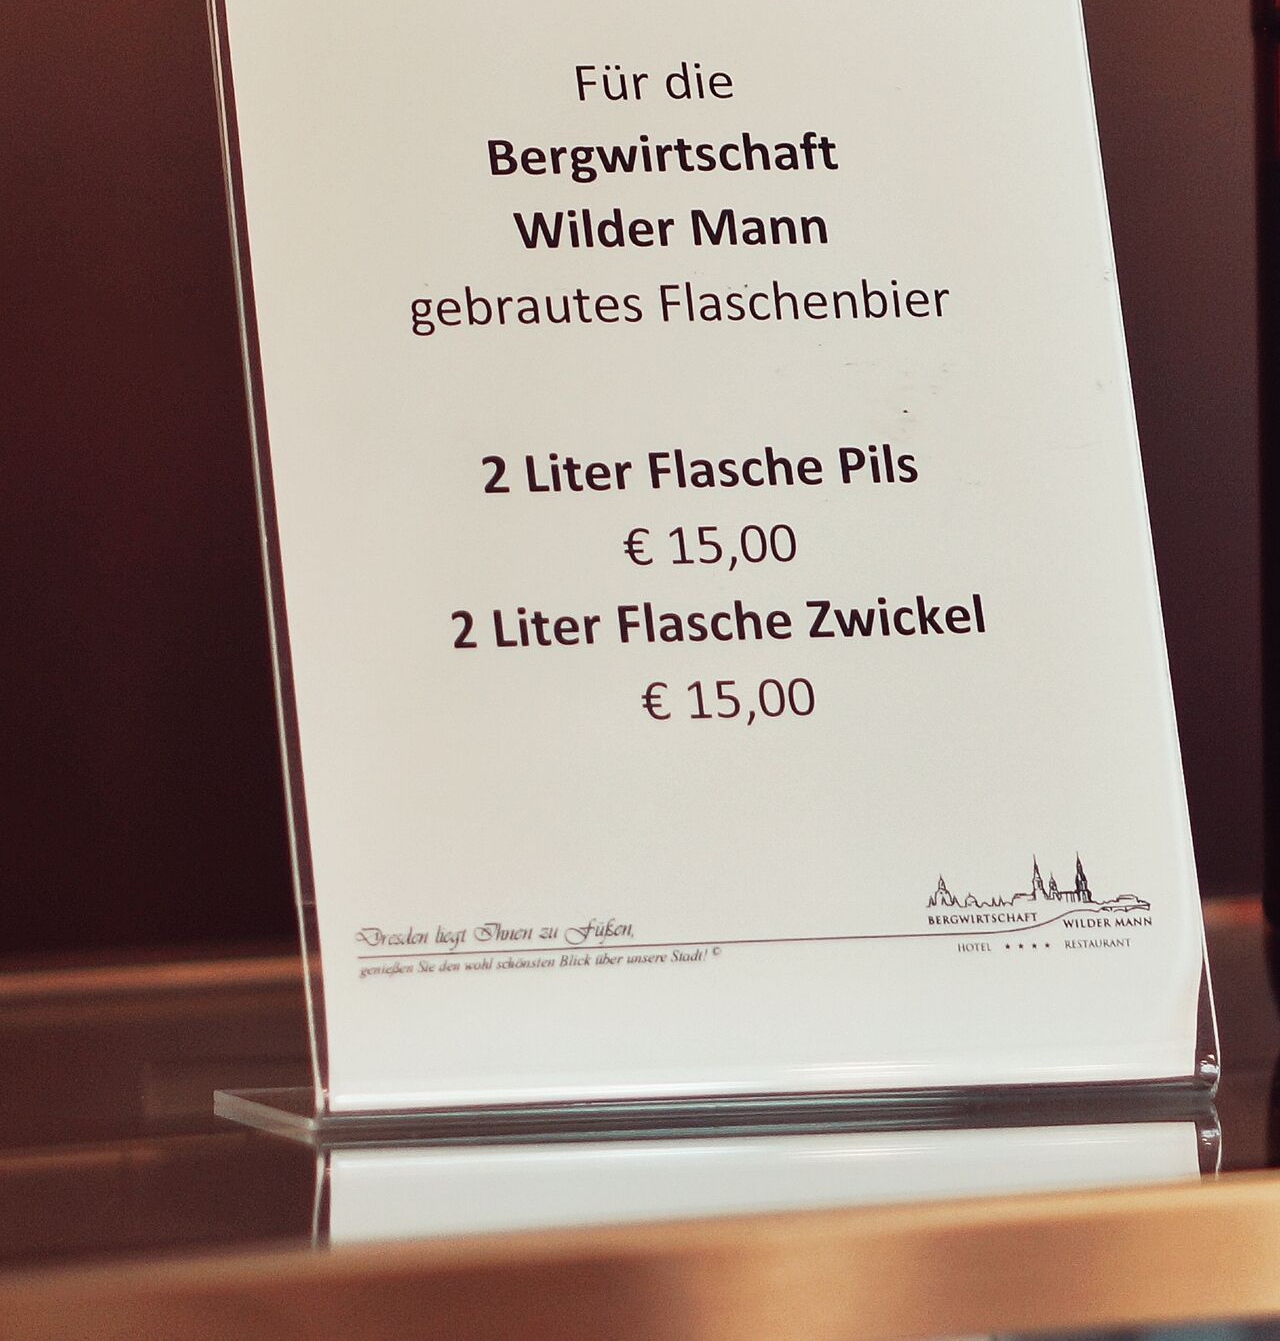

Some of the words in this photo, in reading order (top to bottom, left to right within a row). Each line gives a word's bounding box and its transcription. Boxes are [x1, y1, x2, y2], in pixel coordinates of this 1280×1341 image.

[575, 64, 649, 102] Für
[665, 61, 734, 100] die
[487, 131, 839, 184] Bergwirtschaft
[512, 207, 675, 249] Wilder
[690, 208, 828, 246] Mann
[411, 287, 643, 337] gebrautes
[659, 278, 950, 322] Flaschenbier
[481, 455, 511, 494] 2
[525, 452, 633, 493] Liter
[648, 446, 823, 490] Flasche
[838, 443, 919, 484] Pils
[622, 527, 654, 566] €
[669, 524, 797, 572] 15,00
[451, 610, 478, 649] 2
[493, 606, 601, 648] Liter
[617, 599, 792, 644] Flasche
[805, 593, 986, 639] Zwickel
[641, 681, 671, 721] €
[687, 677, 815, 726] 15,00
[358, 927, 429, 947] Dresden
[435, 925, 467, 951] liegt
[474, 922, 533, 942] Ihnen
[539, 927, 558, 940] zu
[927, 912, 1037, 925] BERGWIRTSCHAFT
[1062, 918, 1111, 928] WILDER
[1115, 917, 1152, 927] MANN
[418, 960, 434, 973] Sie
[438, 959, 460, 972] den
[465, 957, 493, 970] wohl
[559, 954, 590, 967] Blick
[595, 952, 622, 965] über
[626, 951, 667, 964] unsere
[957, 943, 991, 953] HOTEL
[1064, 938, 1130, 949] RESTAURANT
